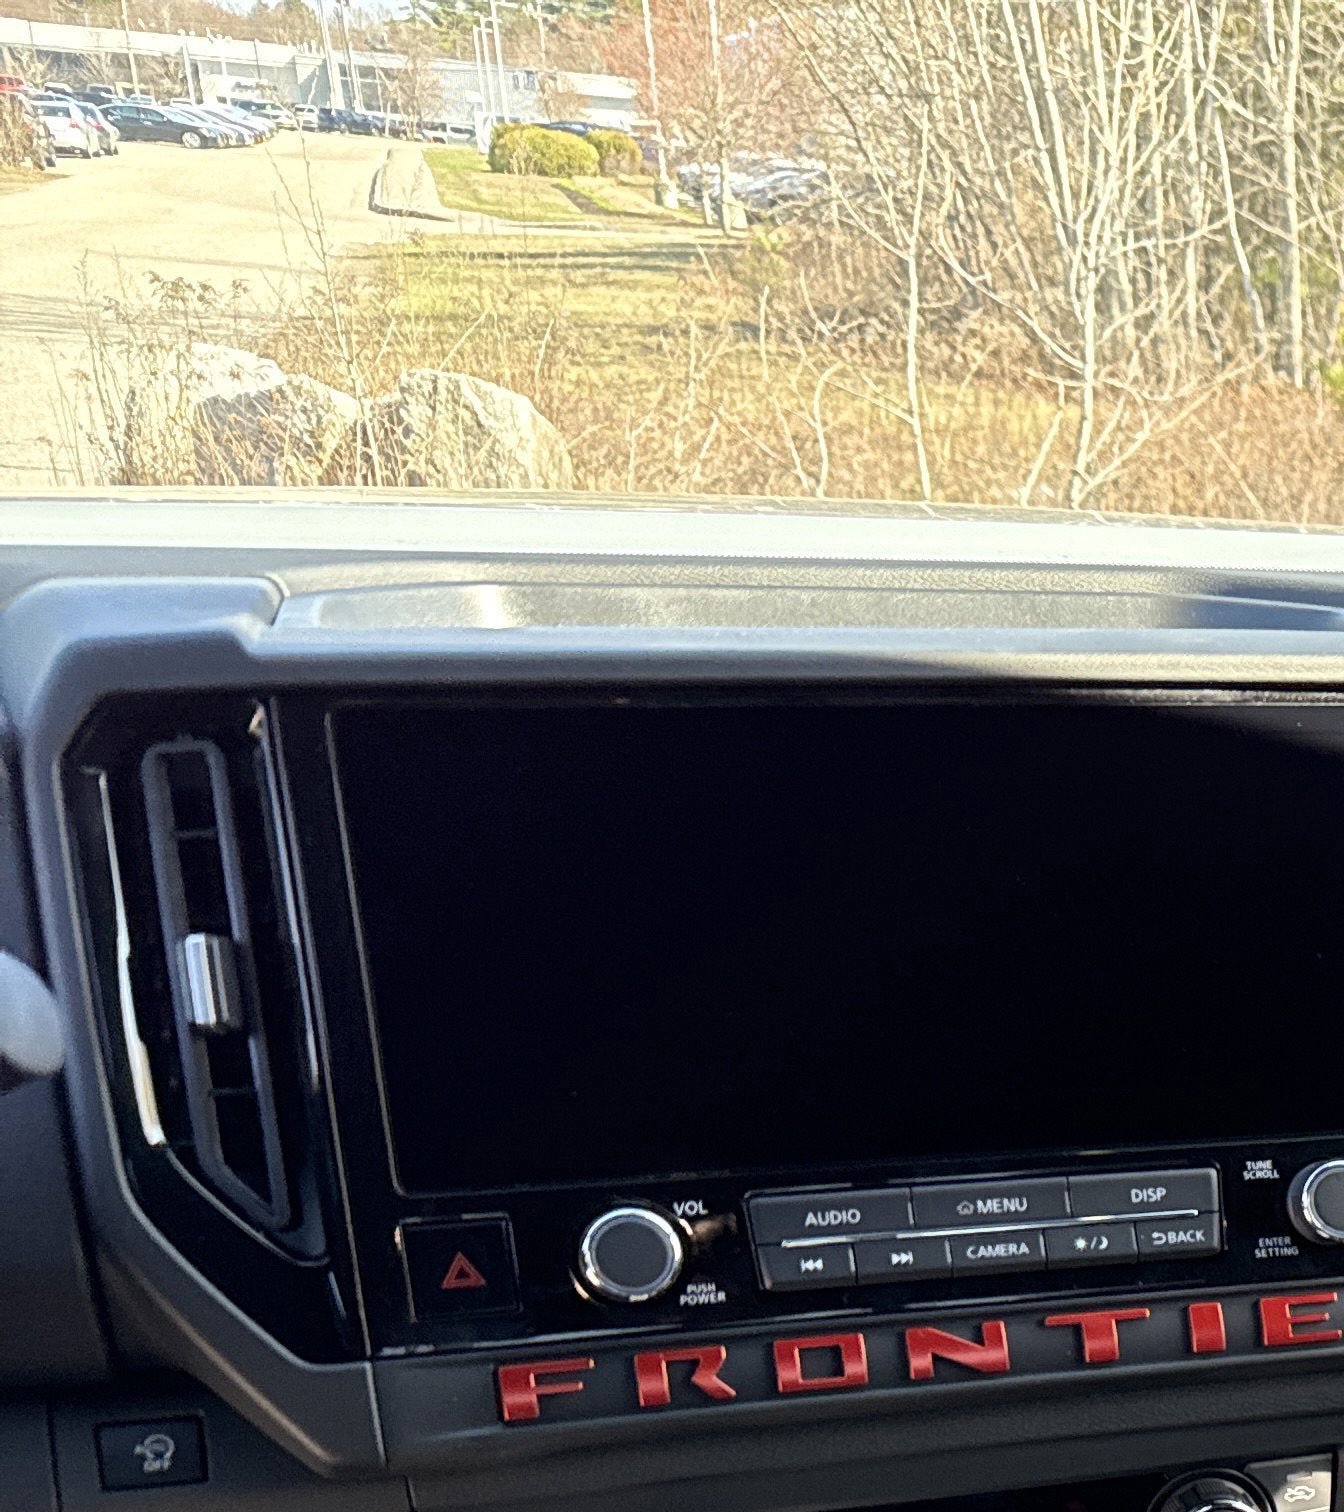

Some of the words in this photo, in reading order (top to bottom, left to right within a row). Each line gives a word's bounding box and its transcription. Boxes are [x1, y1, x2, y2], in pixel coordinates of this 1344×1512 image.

[1245, 1159, 1273, 1171] TUNE
[1242, 1169, 1280, 1181] SCROLL
[1130, 1186, 1167, 1205] DISP
[672, 1199, 709, 1217] VOL
[975, 1197, 1028, 1217] MENU
[804, 1207, 861, 1228] AUDIO
[1167, 1228, 1206, 1245] BACK
[1258, 1236, 1291, 1248] ENTER
[965, 1240, 1030, 1260] CAMERA
[1254, 1246, 1299, 1259] SETTING
[686, 1282, 717, 1295] PUSH
[679, 1291, 727, 1307] POWER
